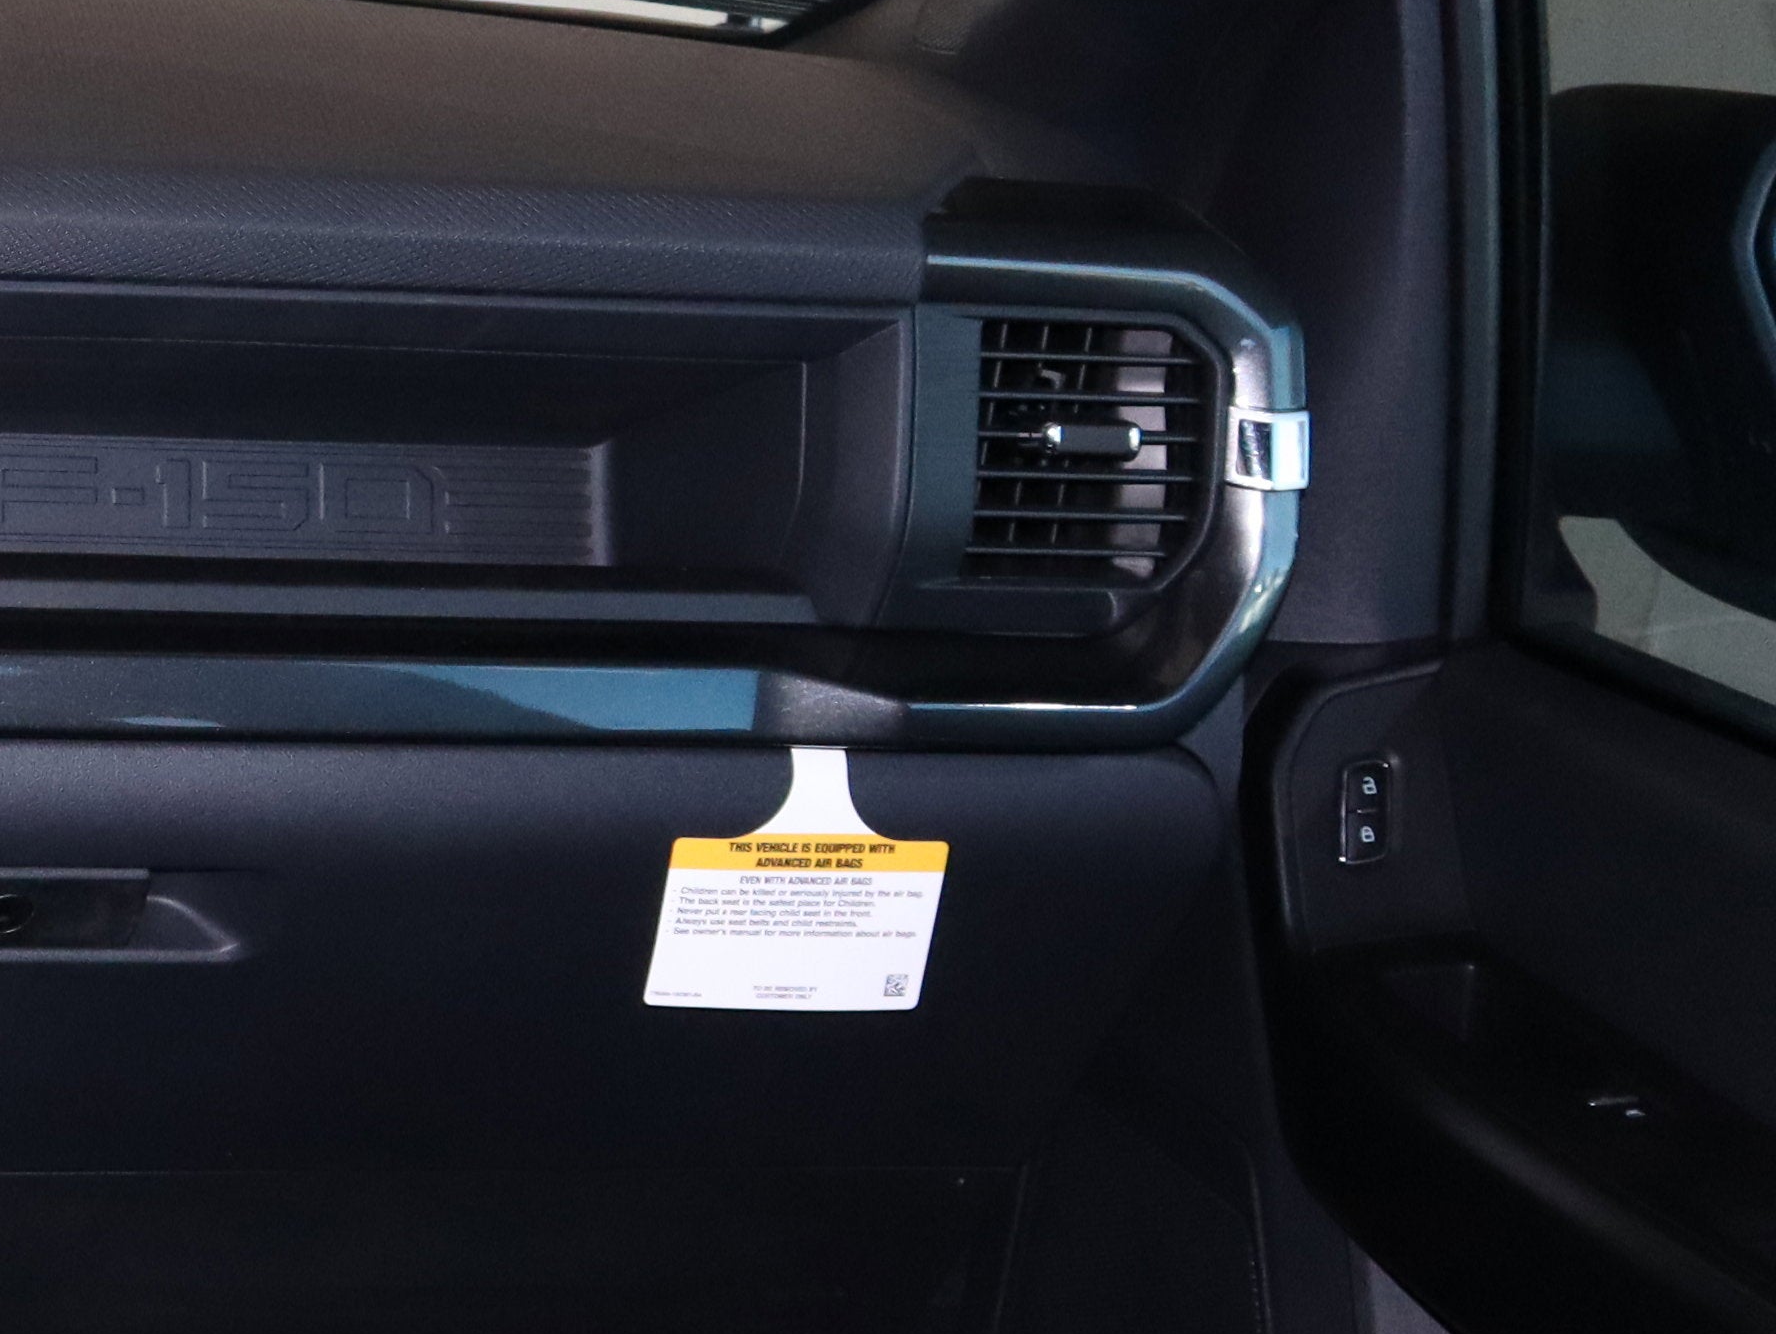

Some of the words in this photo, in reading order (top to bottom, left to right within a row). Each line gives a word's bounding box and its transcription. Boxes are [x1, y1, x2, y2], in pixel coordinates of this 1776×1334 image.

[729, 842, 752, 853] THIS
[756, 843, 799, 853] VEHICLE
[801, 843, 811, 853] IS
[814, 843, 866, 854] EQUIPPED
[869, 844, 896, 854] WITH
[755, 857, 812, 868] ADVANCED
[814, 858, 832, 868] AIR
[835, 858, 864, 868] BAGS
[739, 875, 761, 885] EVEN
[764, 876, 786, 885] WITH
[788, 876, 833, 885] ADVANCED
[834, 877, 849, 885] AIR
[850, 877, 873, 886] BAGS
